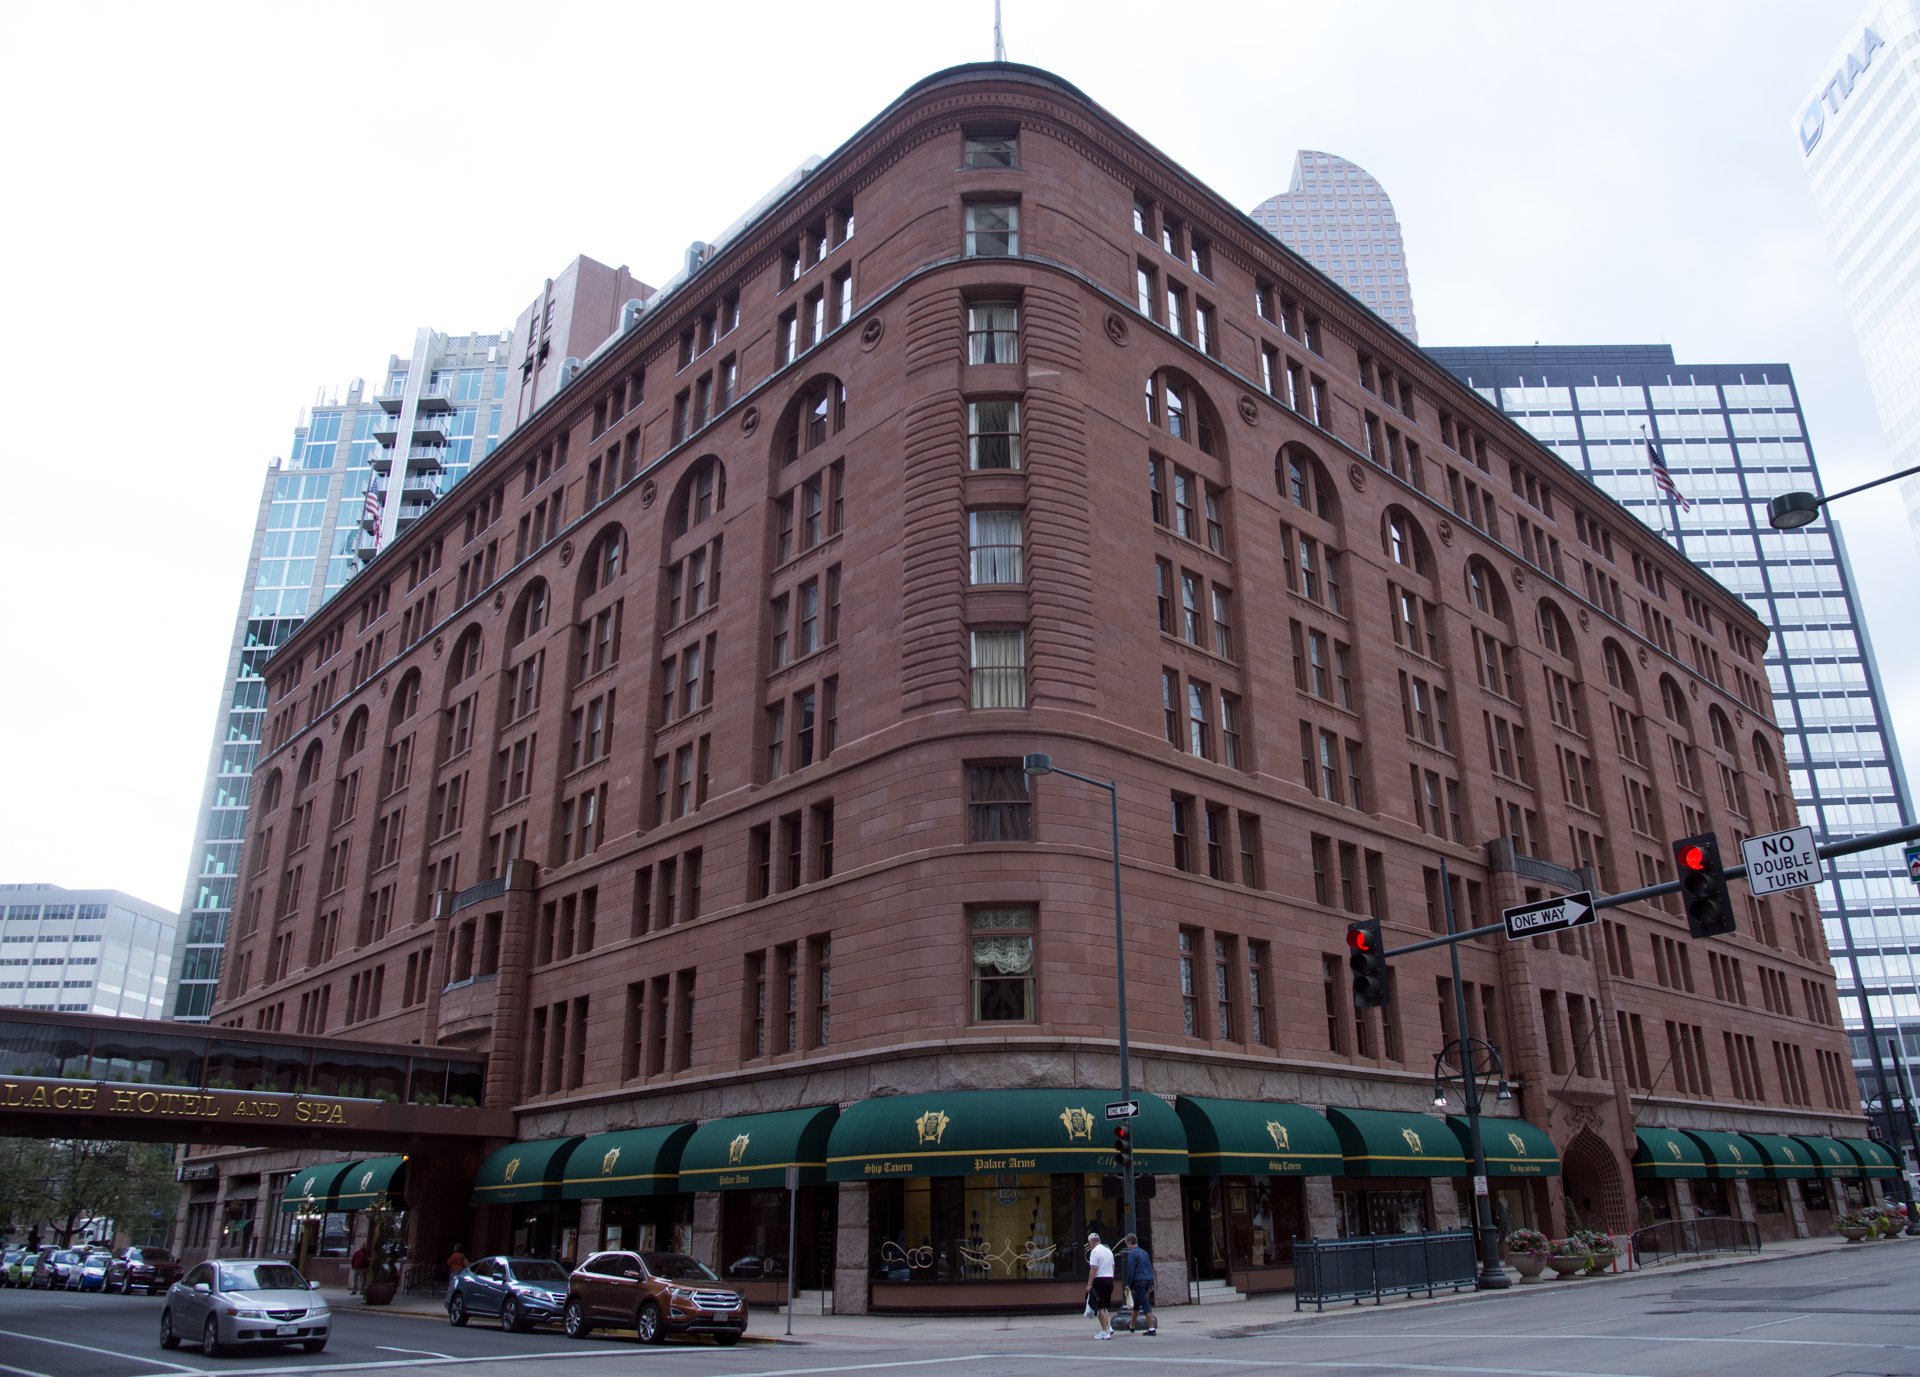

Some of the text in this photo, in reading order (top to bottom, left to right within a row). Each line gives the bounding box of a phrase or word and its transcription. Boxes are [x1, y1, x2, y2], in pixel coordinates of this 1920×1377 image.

[1820, 26, 1885, 115] TIAA
[1761, 835, 1794, 857] NO
[1753, 851, 1813, 876] DOUBLE
[1765, 869, 1809, 889] TURN
[1514, 906, 1565, 929] ONE WAY
[109, 1090, 221, 1117] HOTEL
[232, 1101, 281, 1118] AND
[294, 1101, 347, 1124] SPA
[1108, 1105, 1129, 1115] ONE WAY
[864, 1162, 913, 1175] Ship Tavern
[974, 1157, 1036, 1172] Palace Arms
